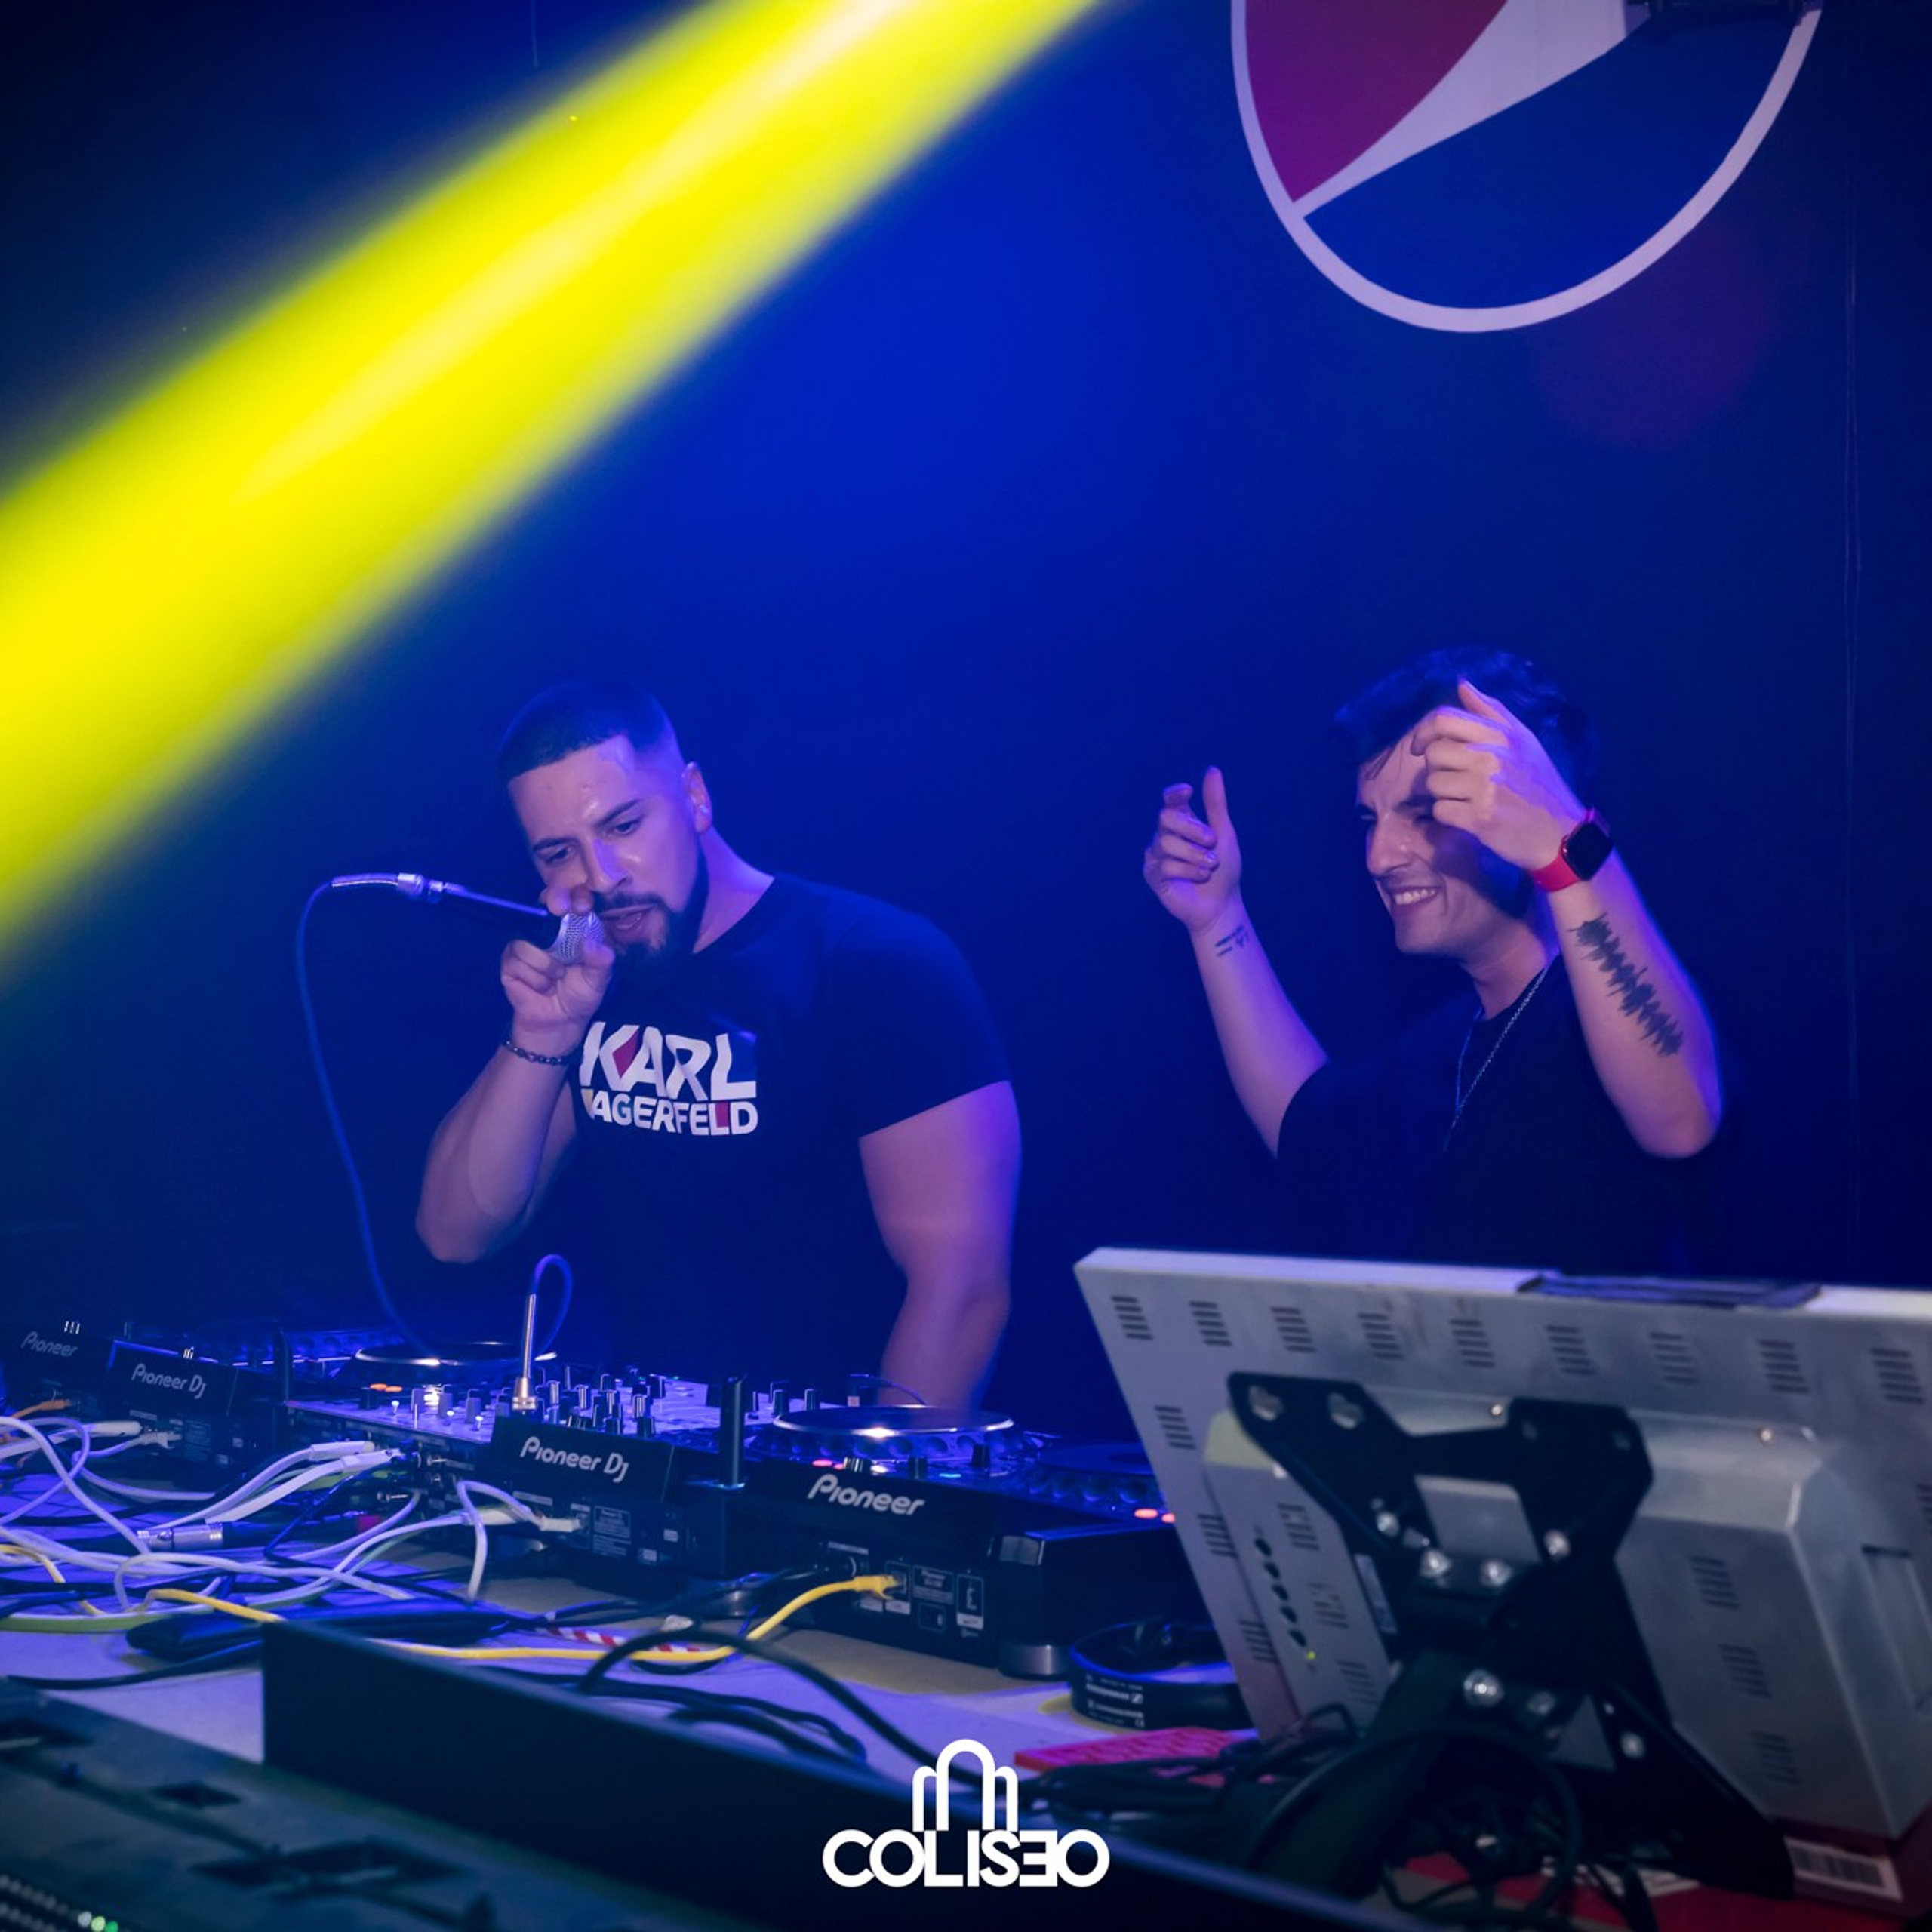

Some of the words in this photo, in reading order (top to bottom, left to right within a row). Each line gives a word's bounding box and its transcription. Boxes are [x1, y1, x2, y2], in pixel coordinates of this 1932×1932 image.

[579, 1021, 756, 1101] KARL
[20, 1331, 78, 1357] Pioneer
[131, 1363, 187, 1391] Pioneer
[520, 1436, 601, 1471] Pioneer
[808, 1473, 925, 1515] Pioneer
